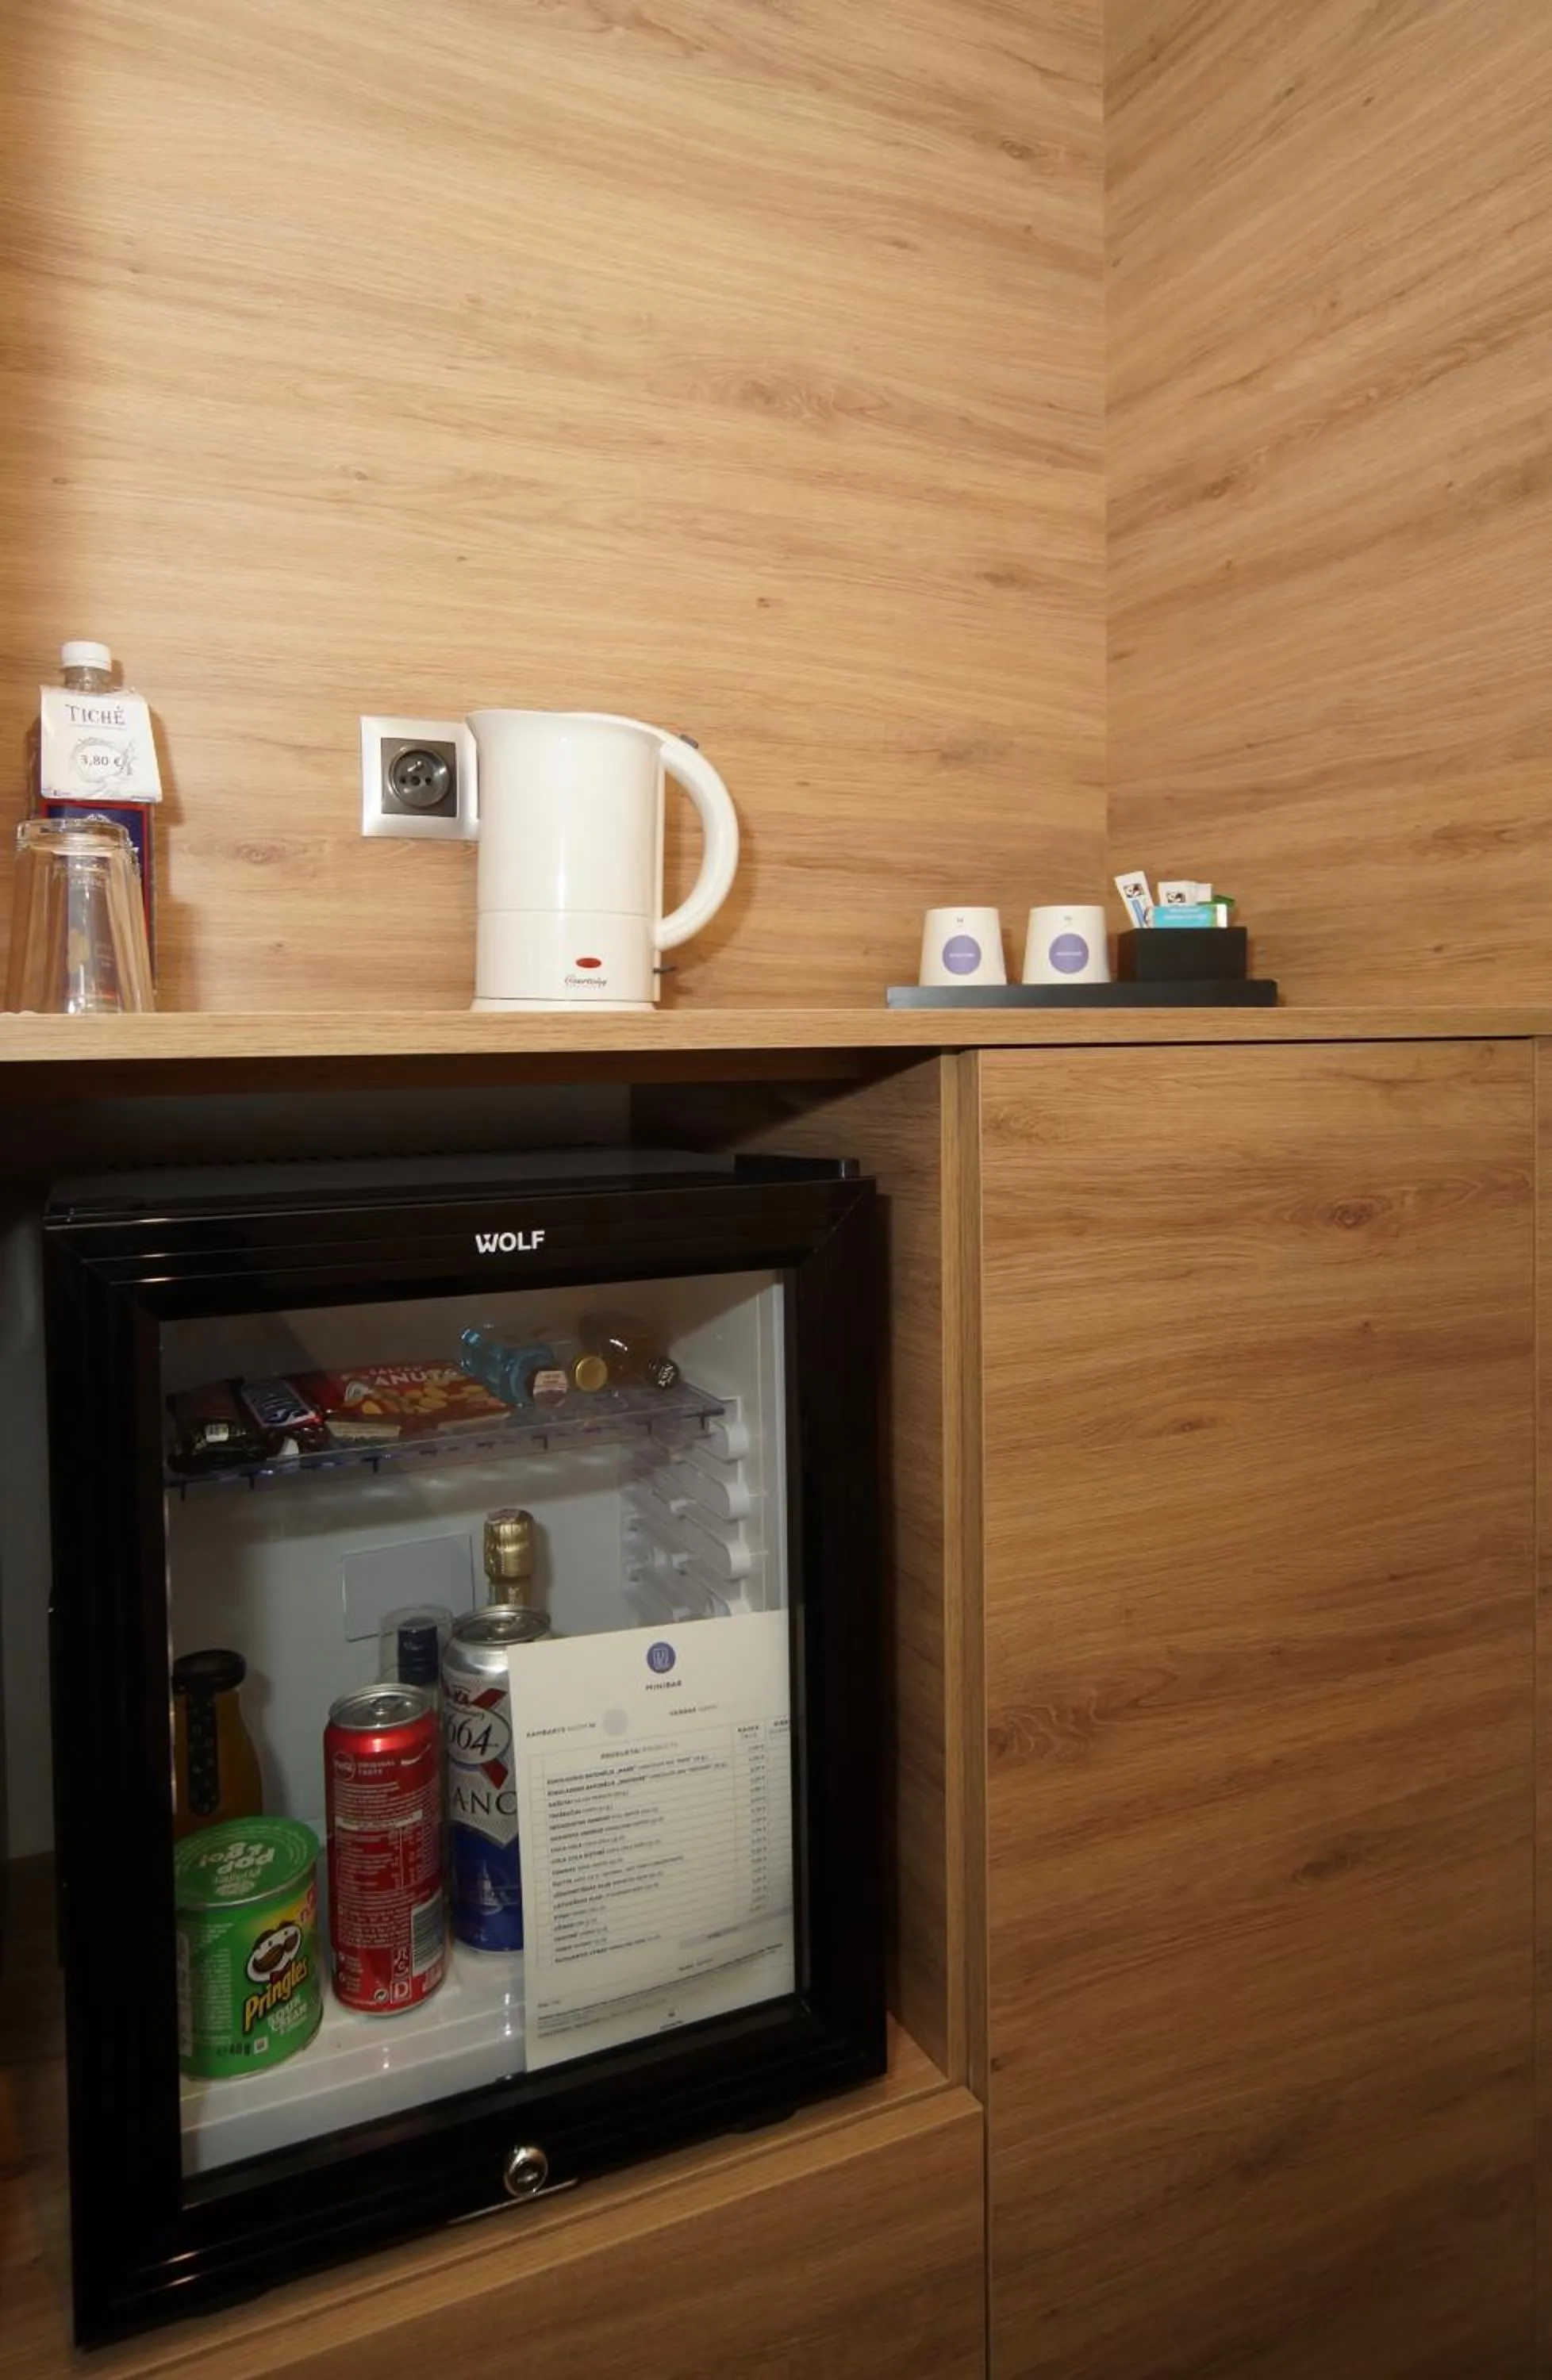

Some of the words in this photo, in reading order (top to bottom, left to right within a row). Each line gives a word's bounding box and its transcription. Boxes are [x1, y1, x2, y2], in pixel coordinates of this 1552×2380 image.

[474, 1230, 545, 1253] WOLF
[645, 1679, 682, 1691] MINIBAR
[243, 1956, 309, 2033] Pringles
